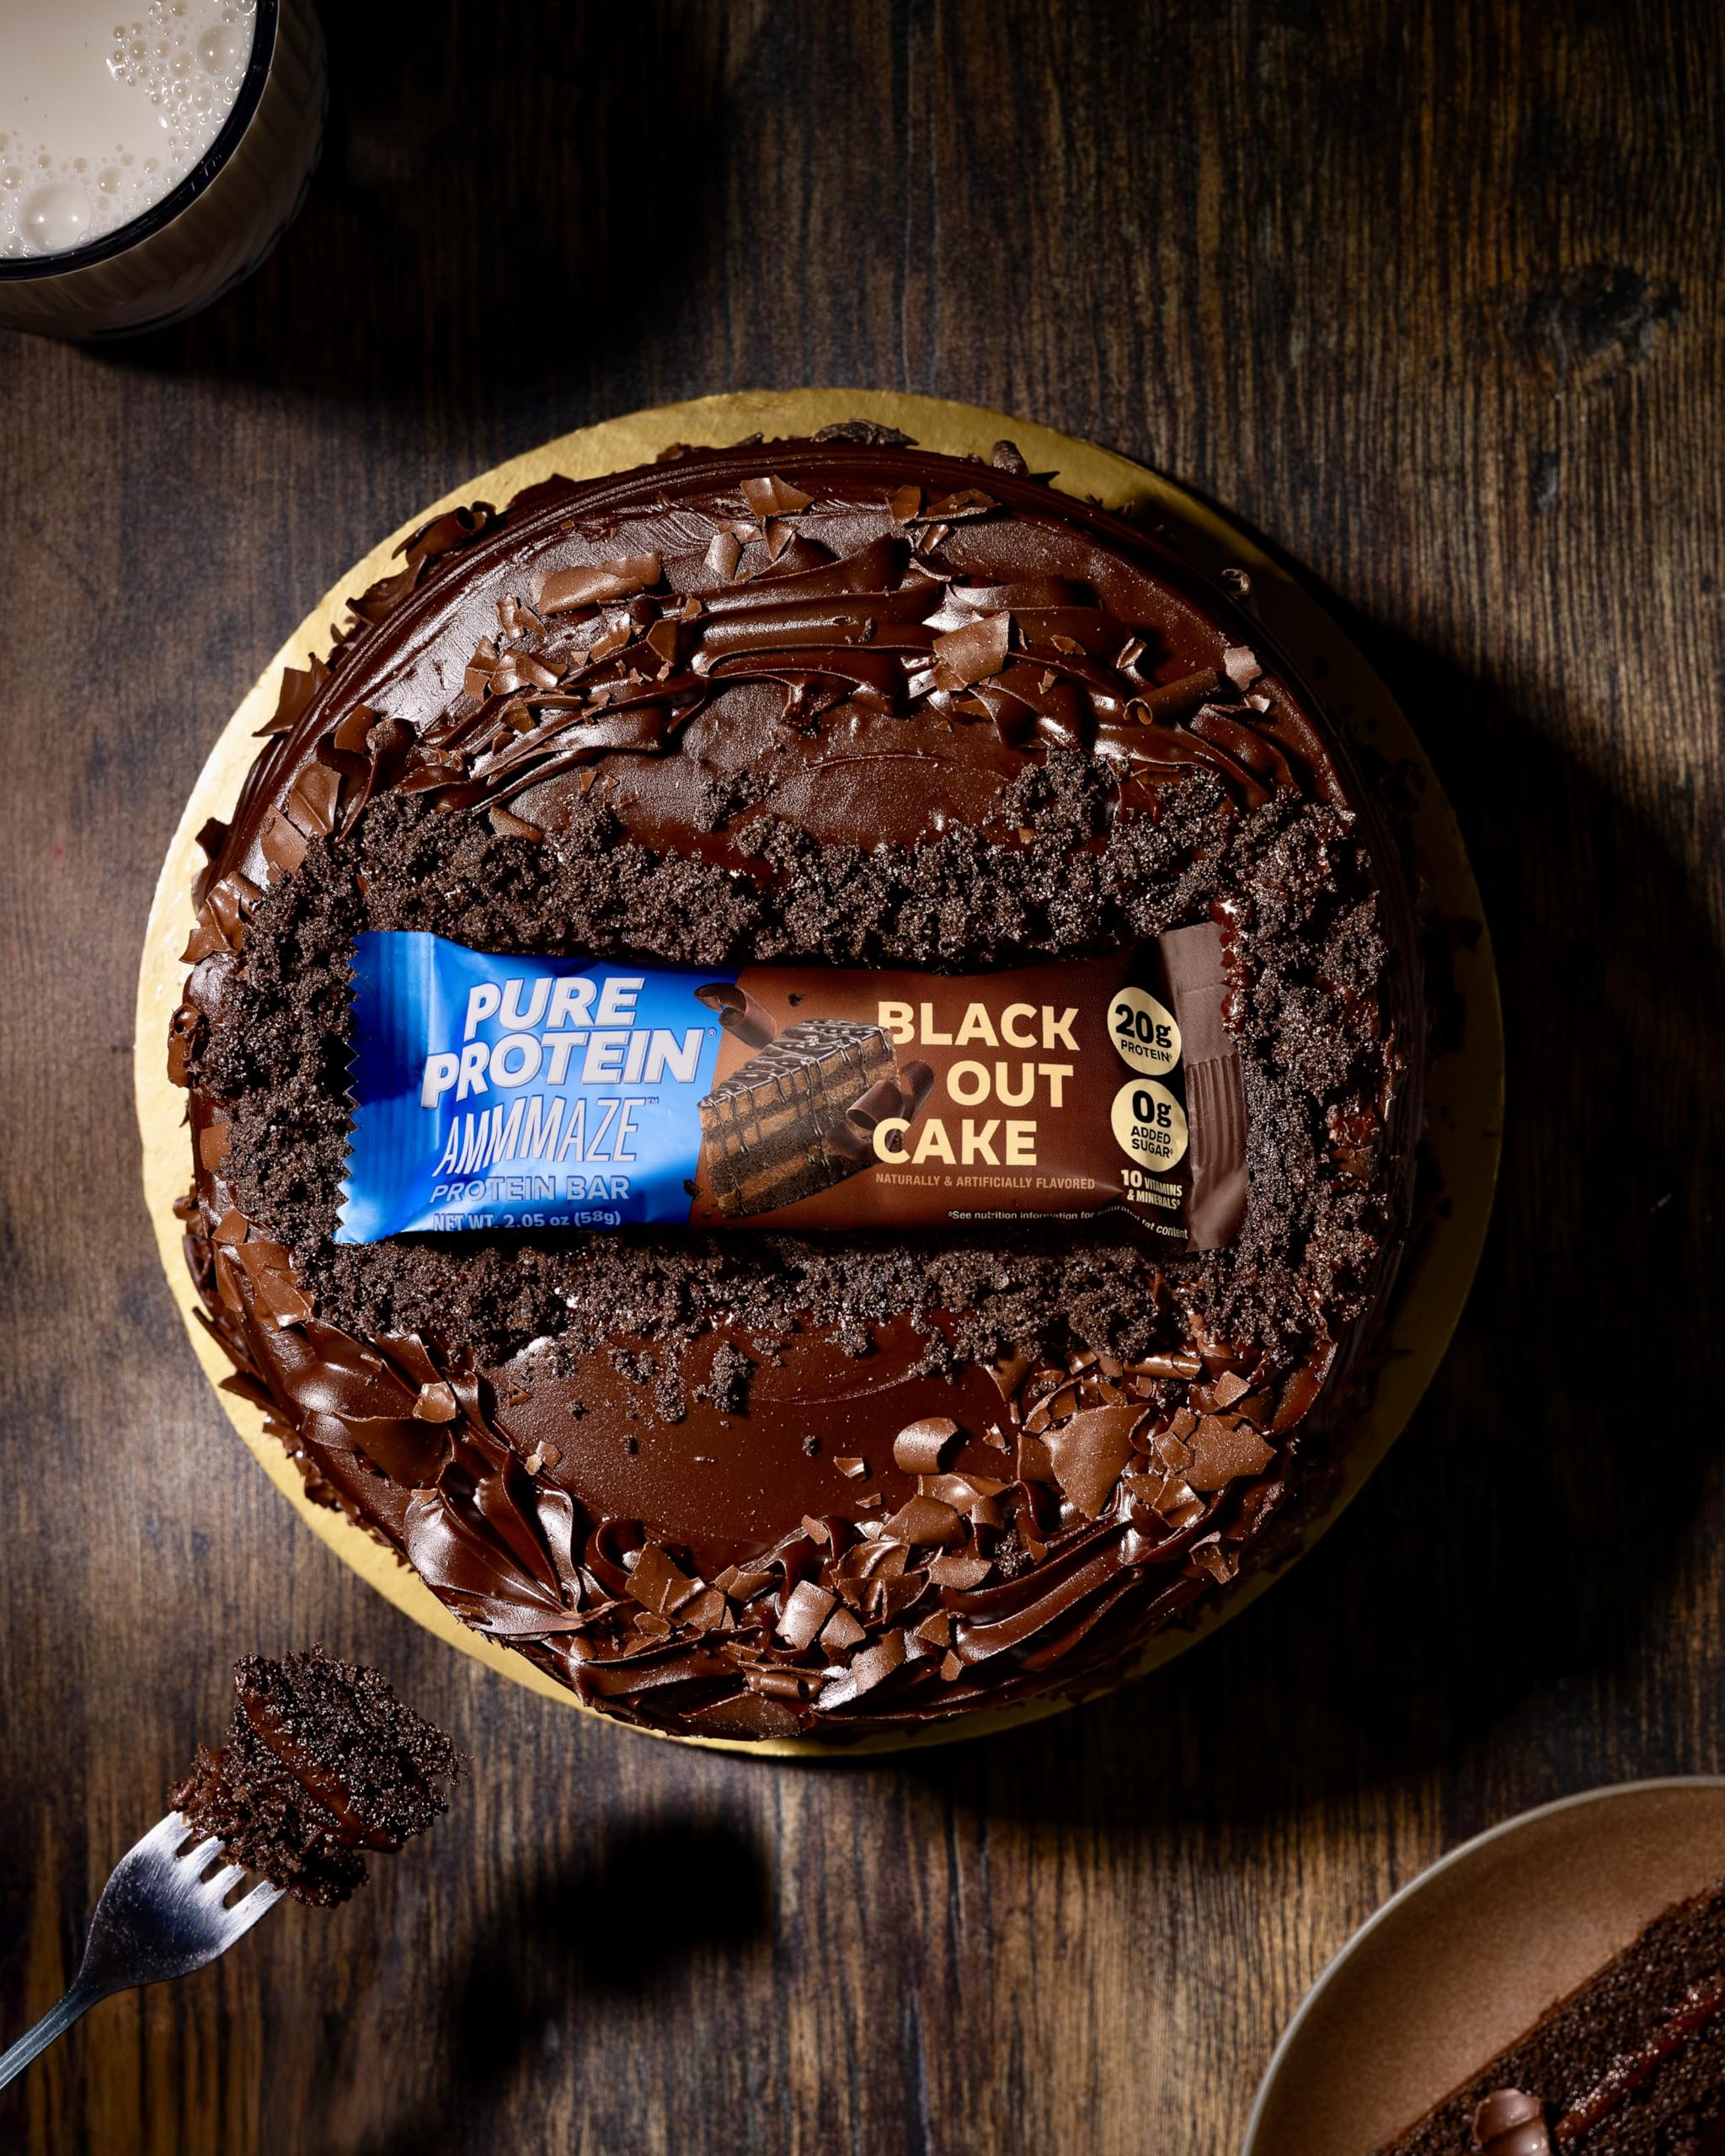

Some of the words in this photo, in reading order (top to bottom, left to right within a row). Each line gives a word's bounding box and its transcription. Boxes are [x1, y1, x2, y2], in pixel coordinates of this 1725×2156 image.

[464, 977, 646, 1042] PURE
[878, 1001, 1080, 1050] BLACK
[1115, 1004, 1172, 1049] 20g
[946, 1060, 1073, 1107] OUT
[1132, 1091, 1172, 1128] 0g
[873, 1118, 1037, 1166] CAKE
[1131, 1126, 1171, 1145] ADDED
[430, 1176, 556, 1203] PROTEIN
[566, 1175, 630, 1200] BAR
[876, 1173, 940, 1186] NATURALLY
[944, 1177, 953, 1187] &
[956, 1177, 1033, 1188] ARTIFICIALLY
[1036, 1177, 1095, 1189] FLAVORED
[1120, 1169, 1142, 1187] 10
[1144, 1177, 1183, 1197] VITAMINS
[1127, 1189, 1135, 1201] &
[432, 1213, 465, 1231] NET
[468, 1214, 499, 1230] WT.
[503, 1213, 545, 1229] 2.05
[550, 1215, 569, 1226] oz
[574, 1210, 622, 1226] (58g)
[975, 1210, 1017, 1219] nutrition
[1081, 1211, 1094, 1219] for
[1142, 1219, 1155, 1230] fat
[1156, 1225, 1188, 1239] content
